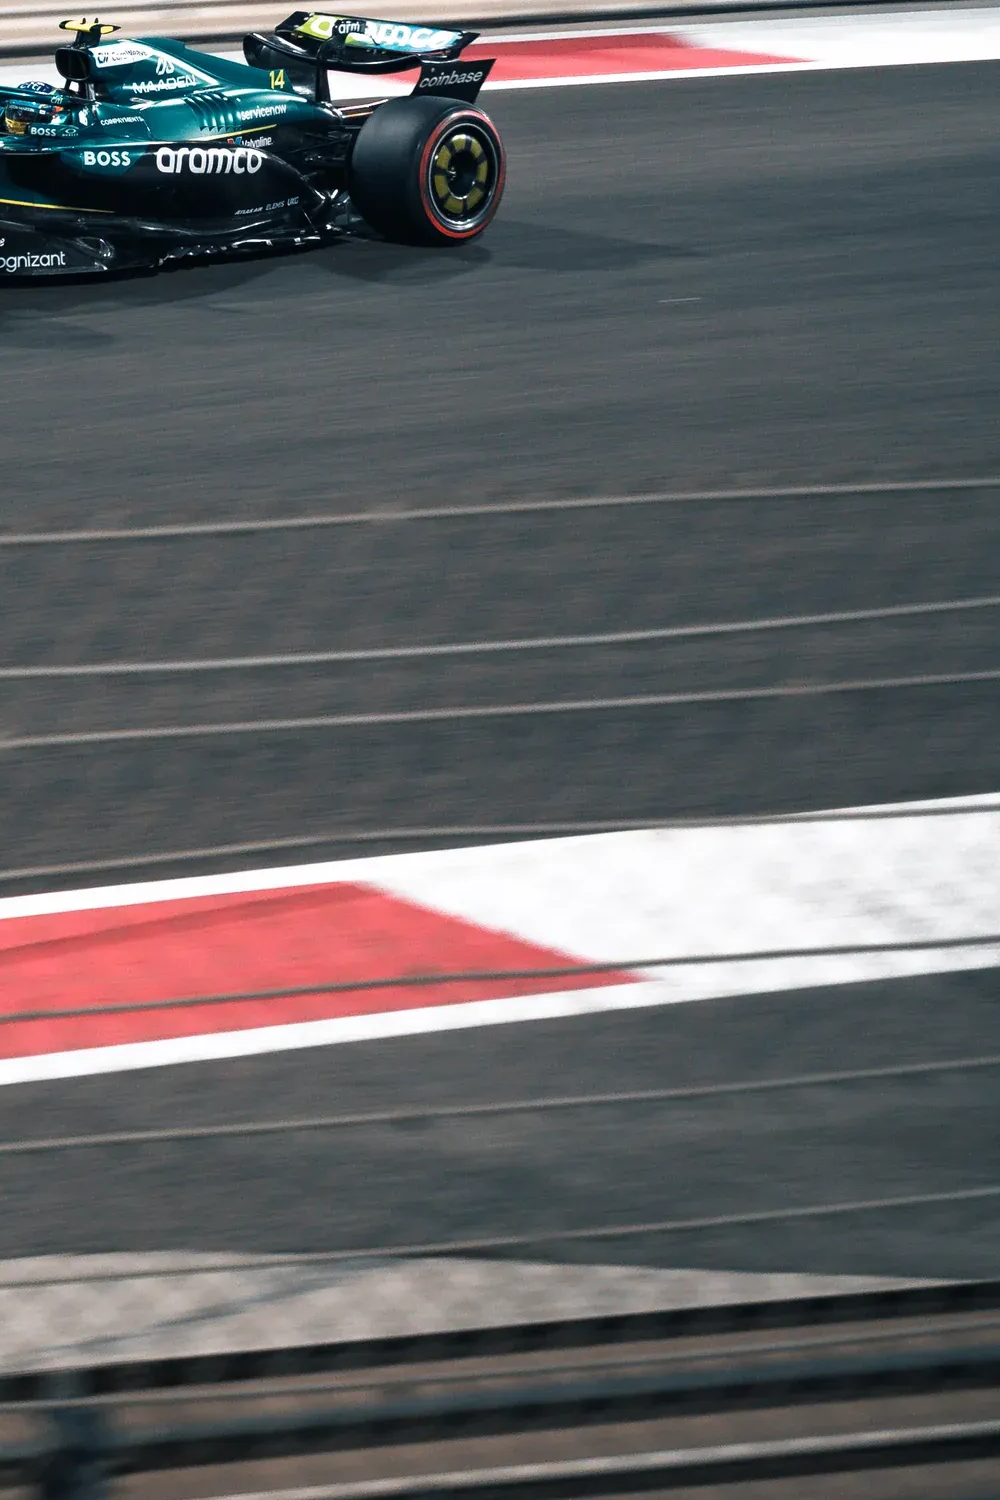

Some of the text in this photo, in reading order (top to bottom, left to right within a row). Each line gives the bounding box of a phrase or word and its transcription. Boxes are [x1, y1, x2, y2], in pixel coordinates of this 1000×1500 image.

[338, 21, 360, 34] arm
[132, 74, 197, 94] MAADEN
[269, 69, 285, 90] 14
[419, 70, 483, 89] coinbase
[241, 104, 287, 121] servicenow
[30, 127, 57, 137] BOSS
[83, 150, 131, 167] BOSS
[156, 147, 263, 174] aramco
